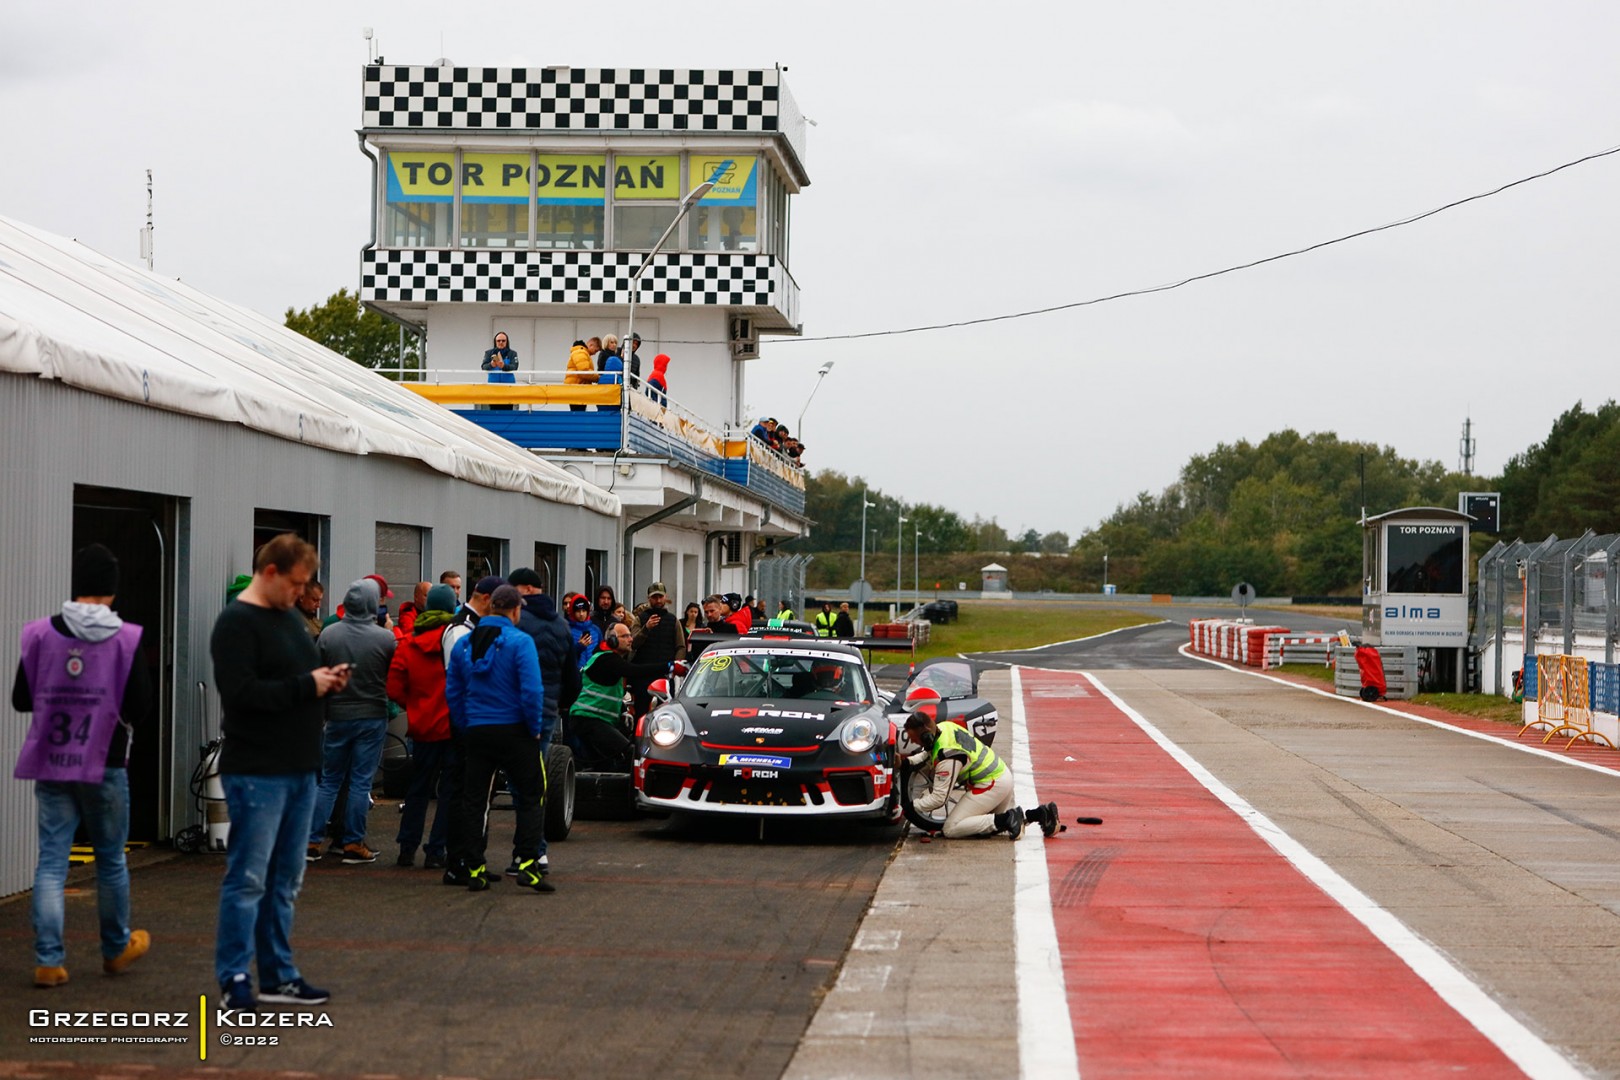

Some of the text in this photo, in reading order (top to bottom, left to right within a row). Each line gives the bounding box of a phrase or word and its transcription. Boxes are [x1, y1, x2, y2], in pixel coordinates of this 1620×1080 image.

[402, 159, 665, 189] TOR POZNAŃ
[142, 369, 150, 402] 6
[1400, 524, 1456, 534] TOR POZNAŃ
[1384, 604, 1441, 619] alma
[697, 655, 732, 674] 79
[47, 710, 93, 748] 34
[740, 756, 783, 766] MICHELIN
